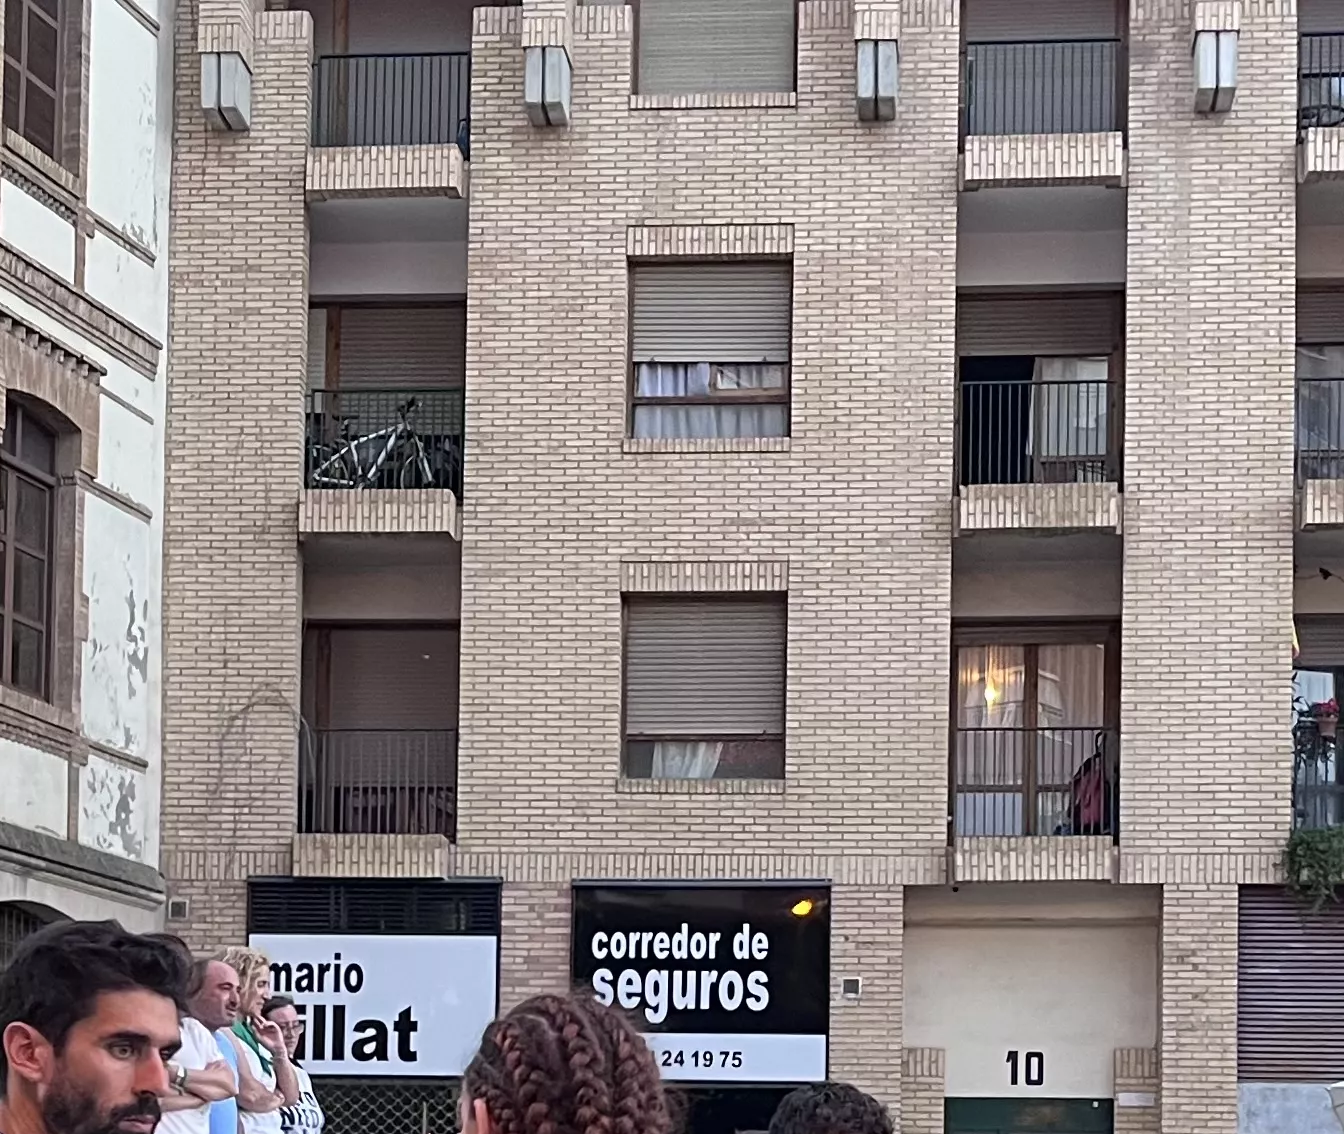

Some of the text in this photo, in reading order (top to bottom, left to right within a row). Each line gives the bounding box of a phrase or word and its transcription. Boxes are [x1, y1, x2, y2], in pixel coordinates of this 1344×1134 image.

[591, 922, 770, 960] corredor de
[269, 952, 364, 993] mario
[592, 968, 770, 1024] seguros
[661, 1050, 743, 1068] 24 19 75
[1005, 1050, 1044, 1086] 10
